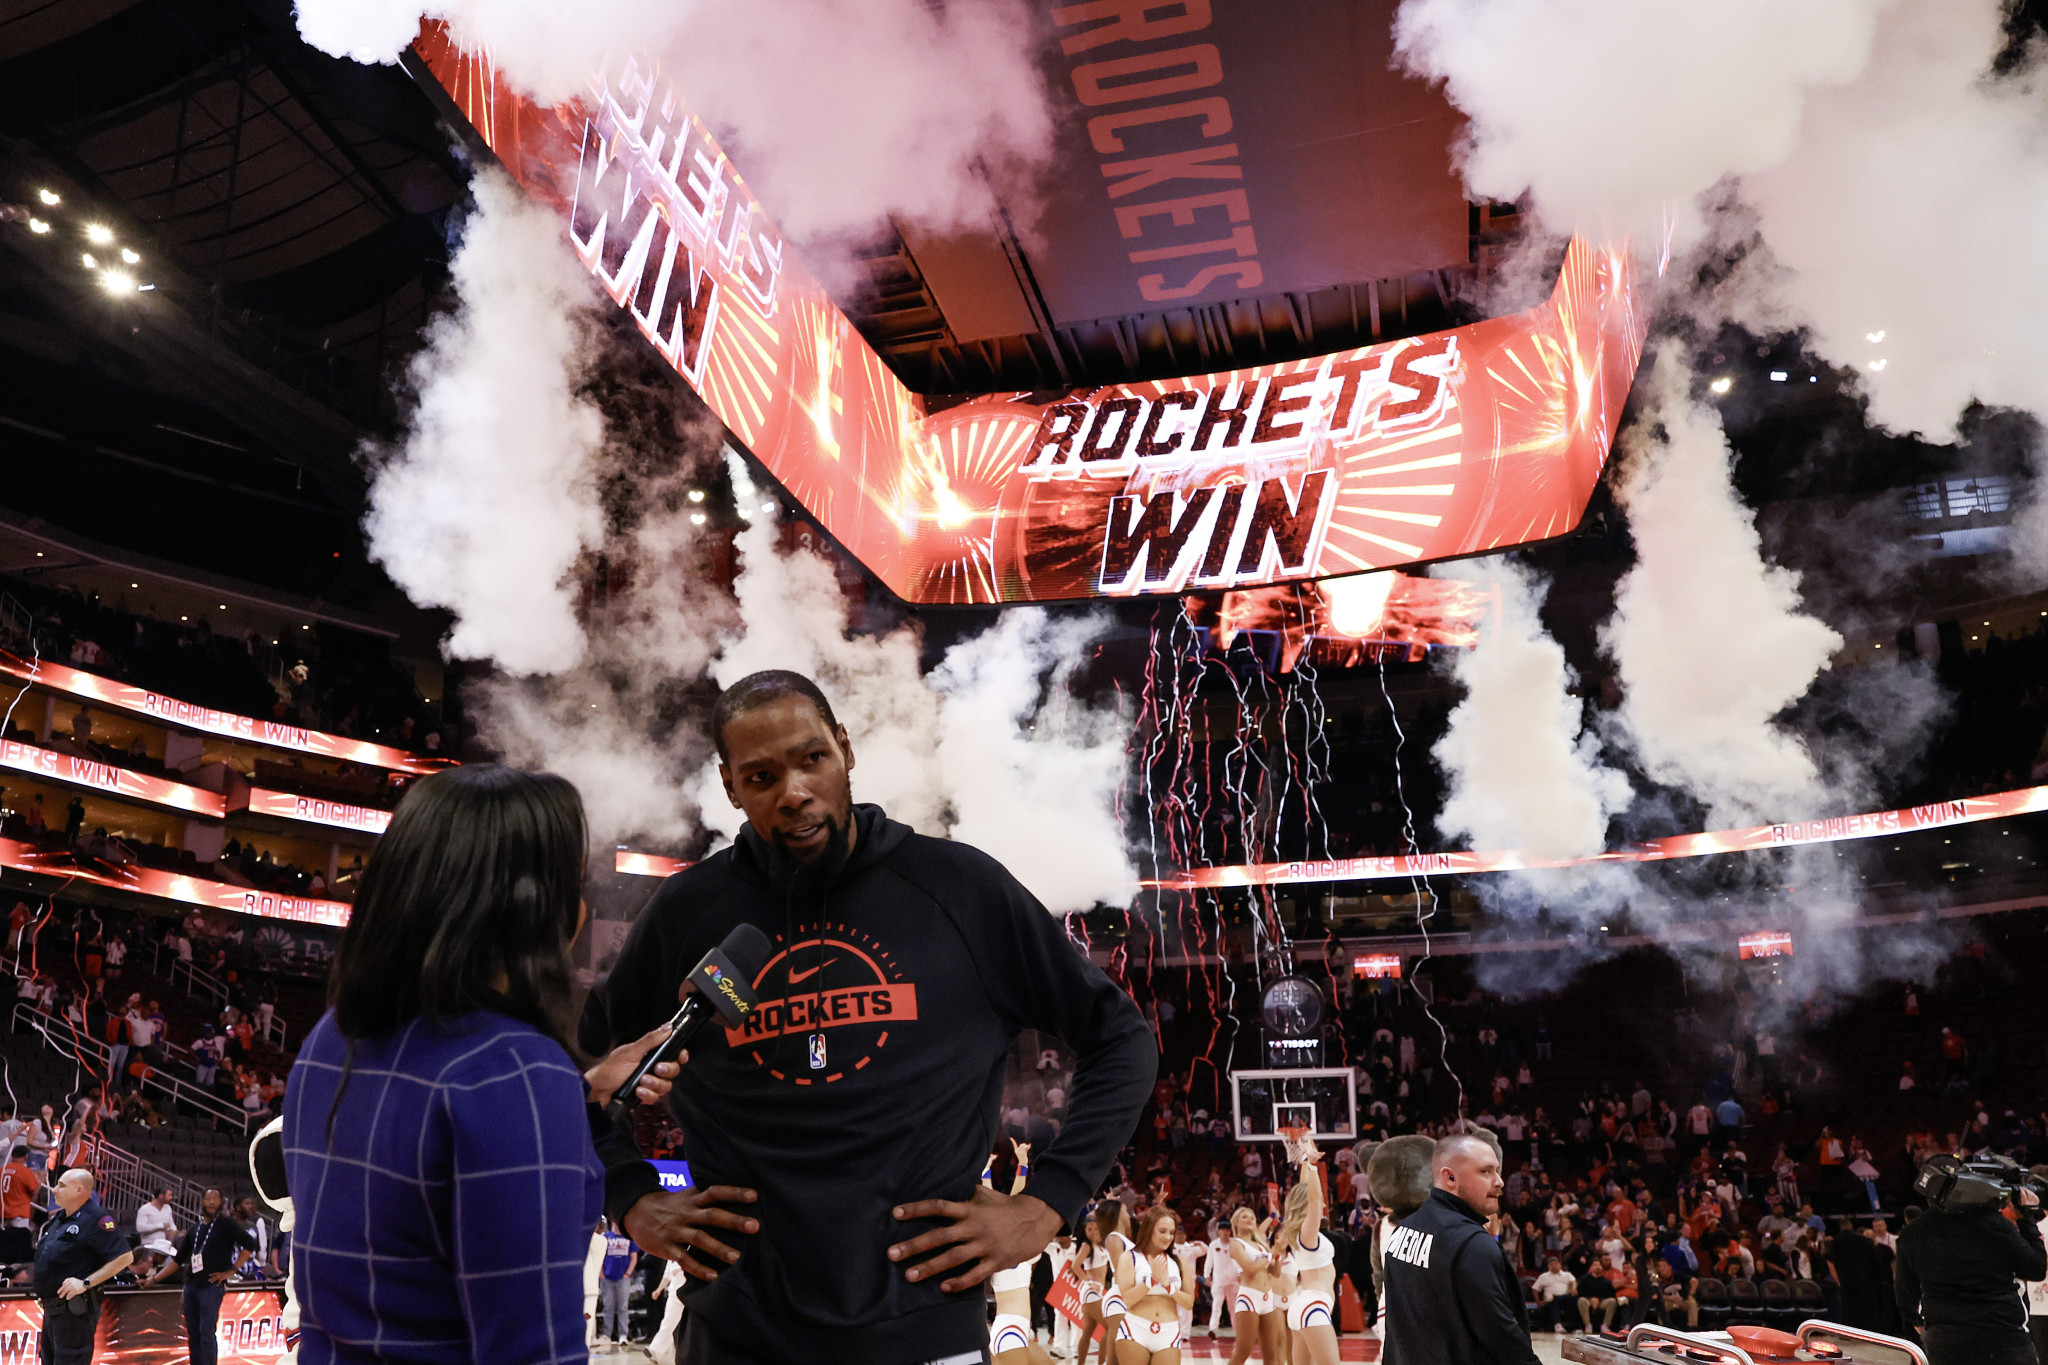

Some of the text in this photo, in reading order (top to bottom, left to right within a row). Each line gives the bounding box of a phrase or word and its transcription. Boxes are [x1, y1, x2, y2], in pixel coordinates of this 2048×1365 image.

[1051, 0, 1264, 302] ROCKETS
[570, 116, 718, 391] WIN
[1019, 336, 1460, 476] ROCKETS
[1099, 468, 1335, 594] WIN
[145, 691, 311, 748] ROCKETS WIN
[1, 740, 120, 789] ETS WIN
[1772, 801, 1968, 843] ROCKETS WIN
[1288, 853, 1451, 879] ROCKETS WIN
[799, 922, 903, 980] BASKETBALL
[718, 977, 749, 1014] Sports
[743, 990, 893, 1038] ROCKETS
[1282, 1039, 1319, 1049] TISSOT
[658, 1172, 687, 1187] TRA
[1386, 1225, 1434, 1269] MEDIA
